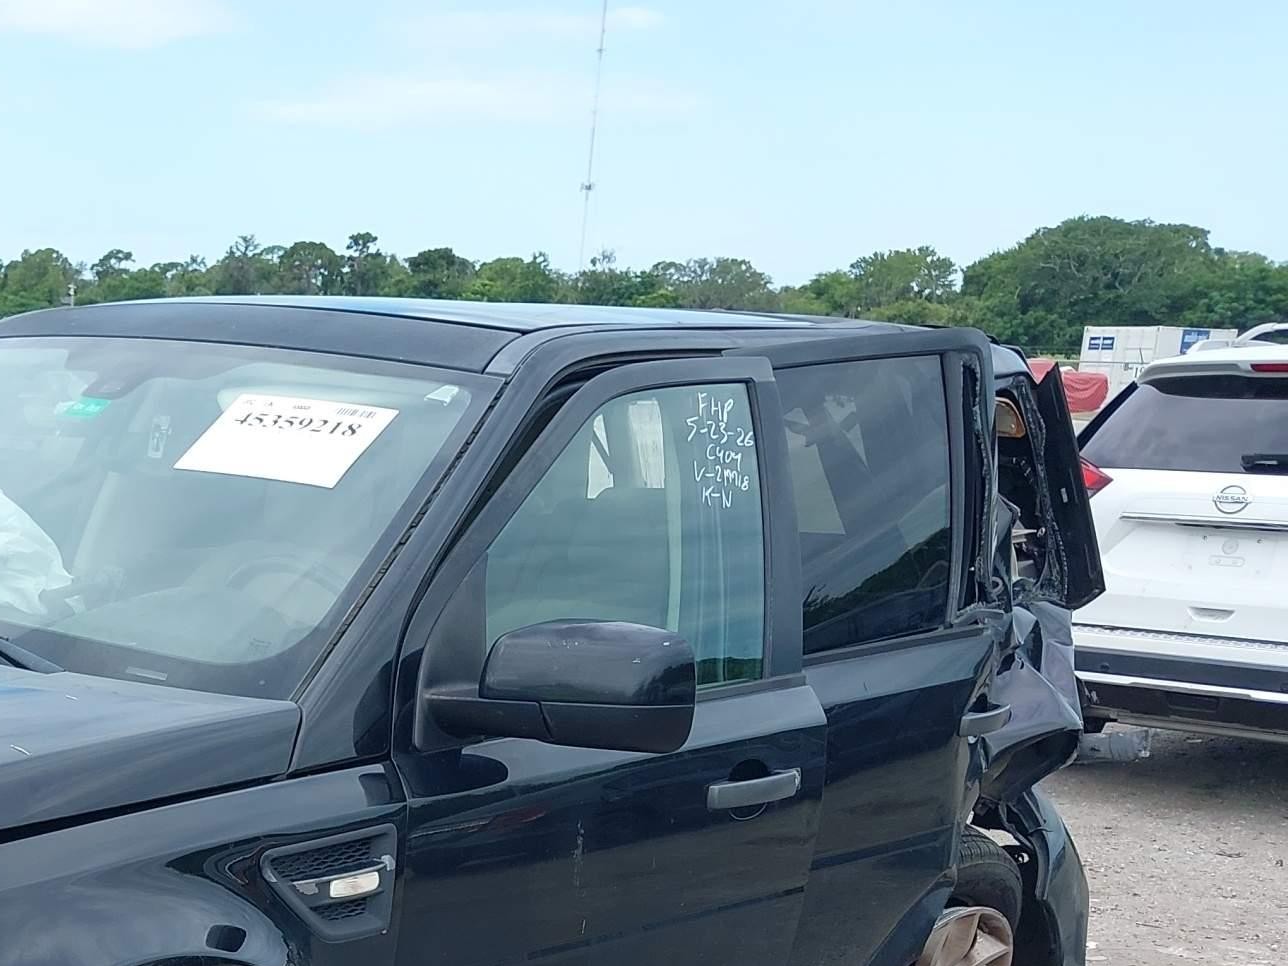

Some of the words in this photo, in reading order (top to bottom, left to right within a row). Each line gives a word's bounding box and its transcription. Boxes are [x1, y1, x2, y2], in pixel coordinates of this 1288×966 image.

[697, 392, 734, 422] FHP
[234, 412, 363, 437] 45359218
[686, 416, 754, 446] 5-23-26
[702, 486, 732, 509] K-N
[1215, 494, 1249, 504] NISSAN
